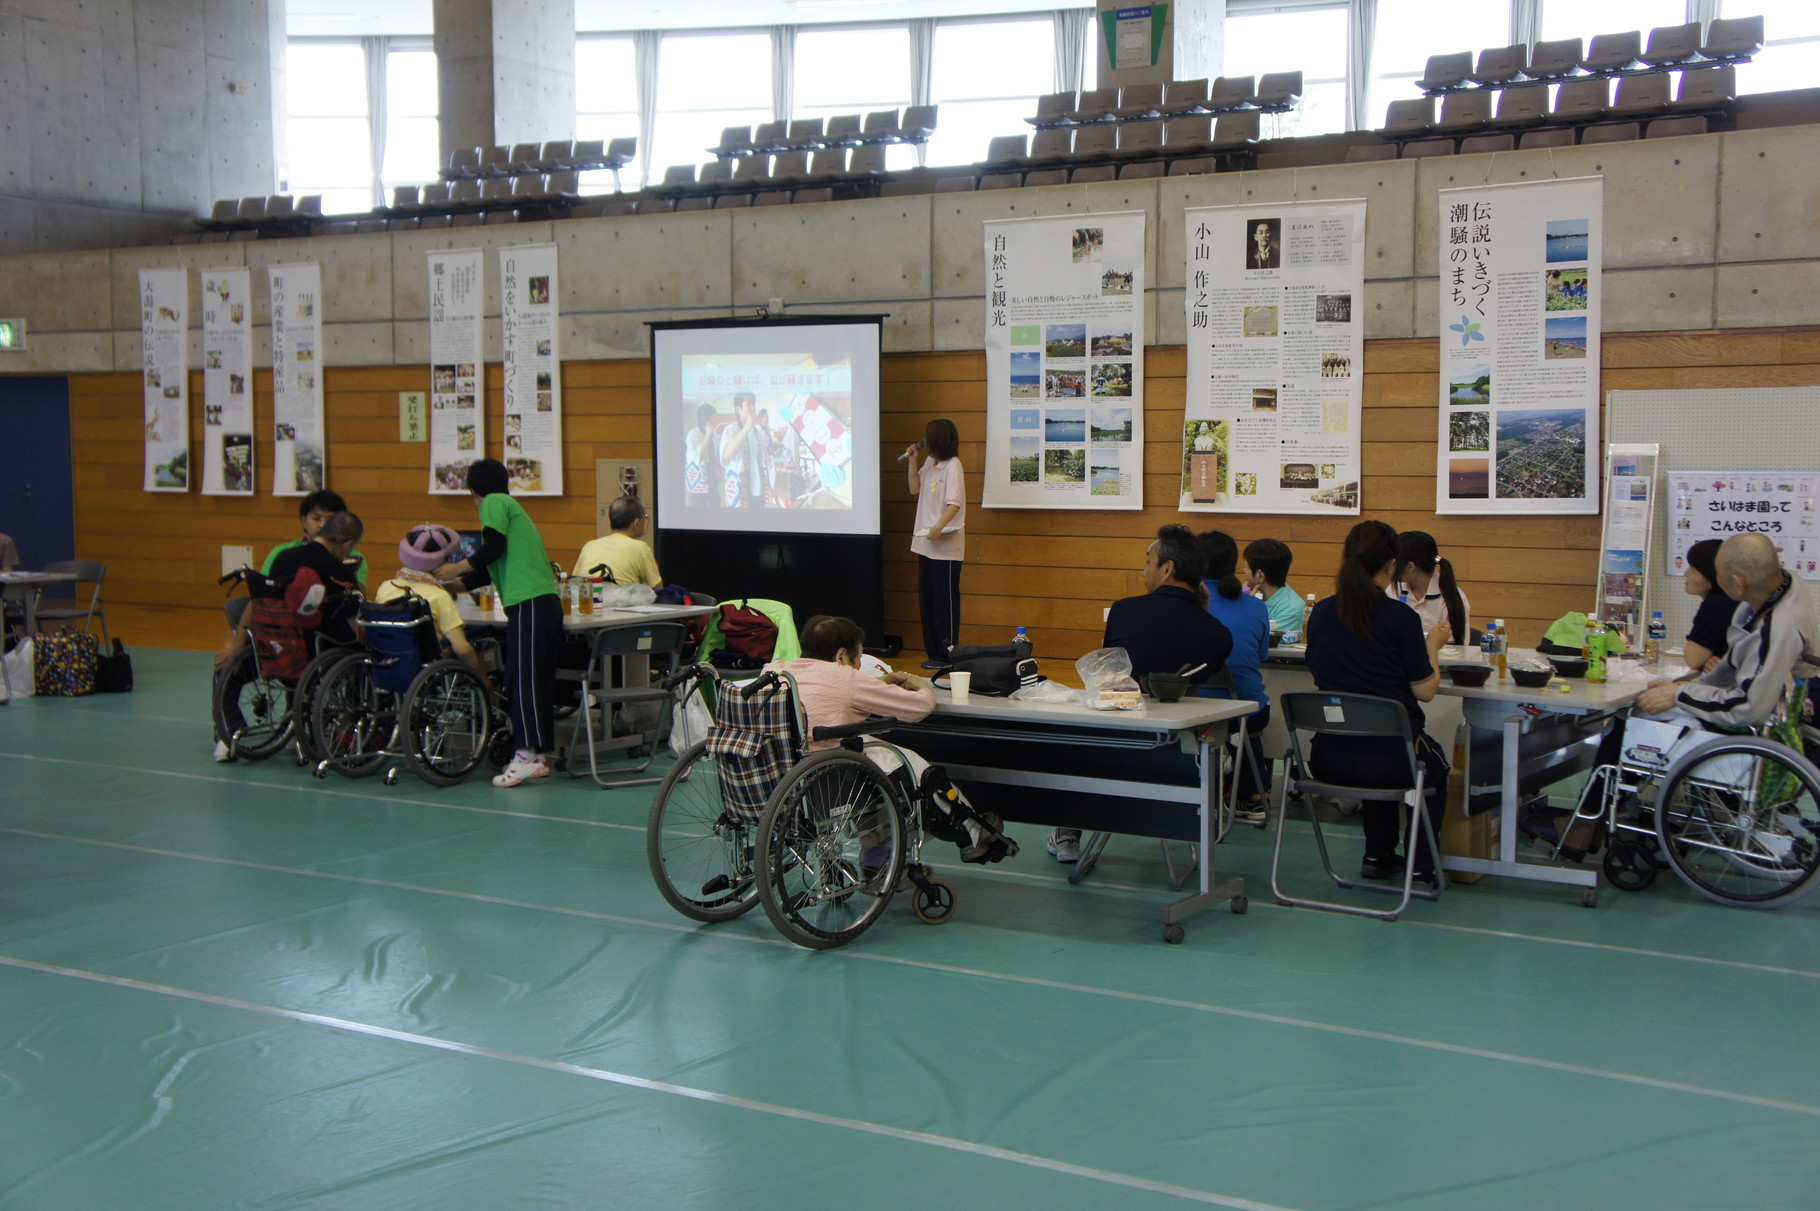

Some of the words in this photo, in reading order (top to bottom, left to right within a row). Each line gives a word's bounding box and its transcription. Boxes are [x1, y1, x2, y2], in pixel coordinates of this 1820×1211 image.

[432, 262, 445, 323] 郷土民謡
[991, 234, 1007, 327] 自然と観光
[1192, 222, 1211, 329] 小山作之助
[1450, 203, 1469, 307] 潮騒のまち
[1471, 201, 1492, 317] 伝説いきづく
[144, 279, 154, 367] 大潟町の伝説
[273, 276, 285, 393] 町の産業と特産品
[504, 258, 518, 408] 自然をいかす町づくり
[1708, 500, 1792, 513] さいはま園って
[1710, 520, 1783, 533] こんなところ
